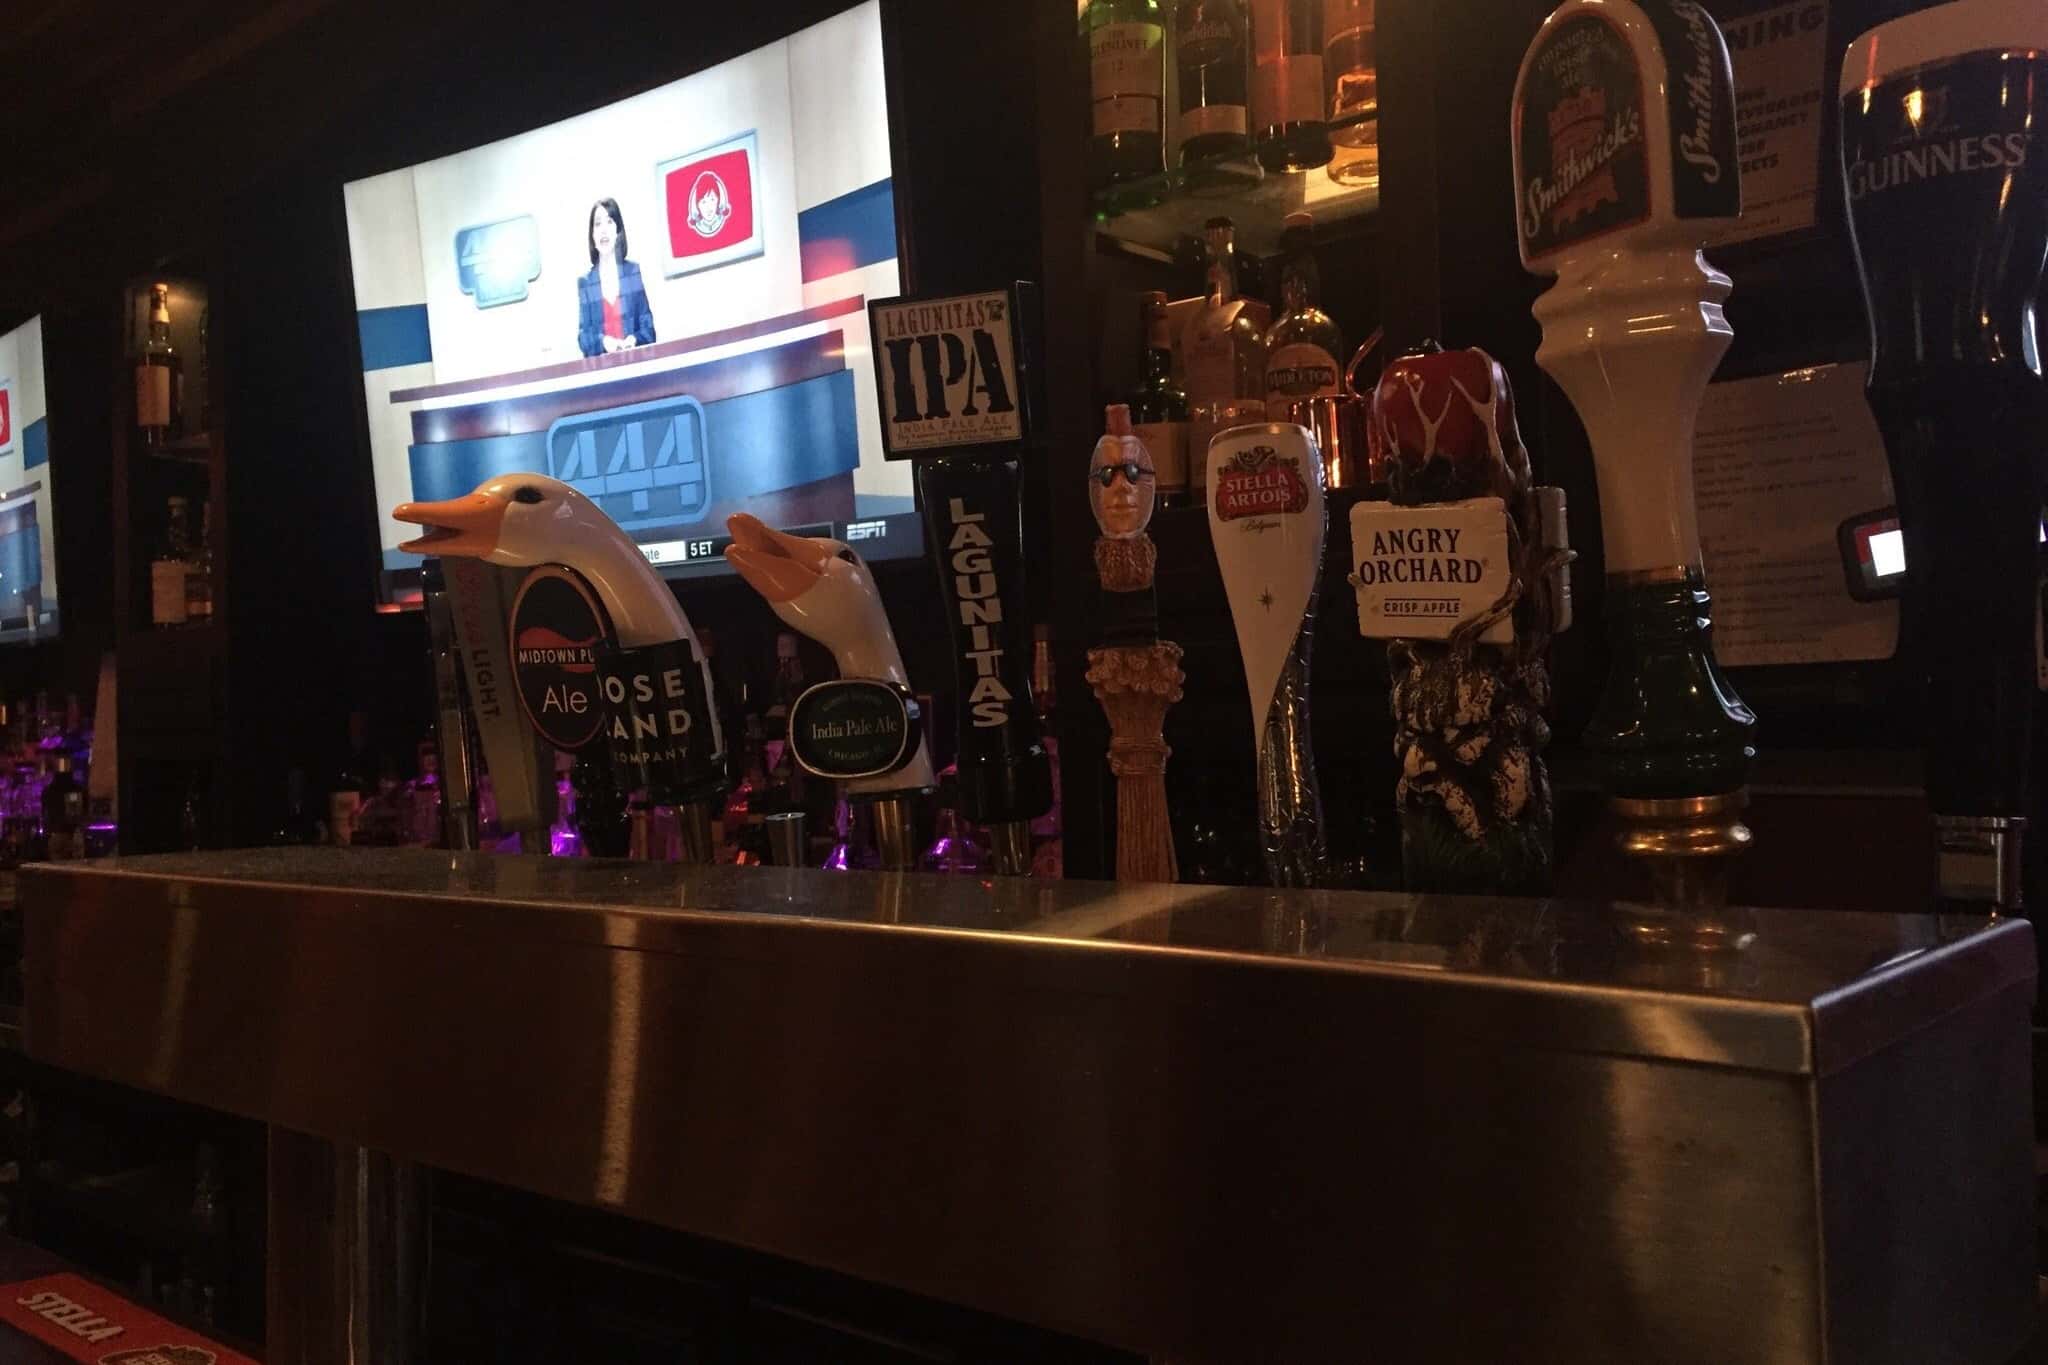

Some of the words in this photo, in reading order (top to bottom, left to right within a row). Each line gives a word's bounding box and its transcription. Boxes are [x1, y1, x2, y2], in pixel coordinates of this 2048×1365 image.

[1728, 7, 1824, 50] NING
[1525, 106, 1642, 238] Smithwick's
[1849, 132, 2026, 201] GUINNESS
[885, 300, 986, 338] LAGUNITAS
[884, 329, 1015, 423] IPA
[1226, 472, 1289, 493] STELLA
[1228, 488, 1291, 507] ARTOIS
[847, 521, 887, 540] ESPN
[1372, 528, 1461, 557] ANGRY
[1360, 558, 1483, 585] ORCHARD
[949, 497, 1014, 728] LAGUNITAS
[1384, 601, 1418, 614] CRISP
[1423, 600, 1461, 614] APPLE
[518, 648, 577, 664] MIDTOWN
[580, 648, 596, 663] PU
[472, 650, 501, 718] LIGHT
[542, 683, 589, 714] Ale
[604, 668, 686, 704] OSE
[612, 708, 692, 740] AND
[811, 721, 844, 740] India
[846, 718, 873, 737] Pale
[876, 714, 897, 734] Ale
[16, 1291, 125, 1343] STELLA
